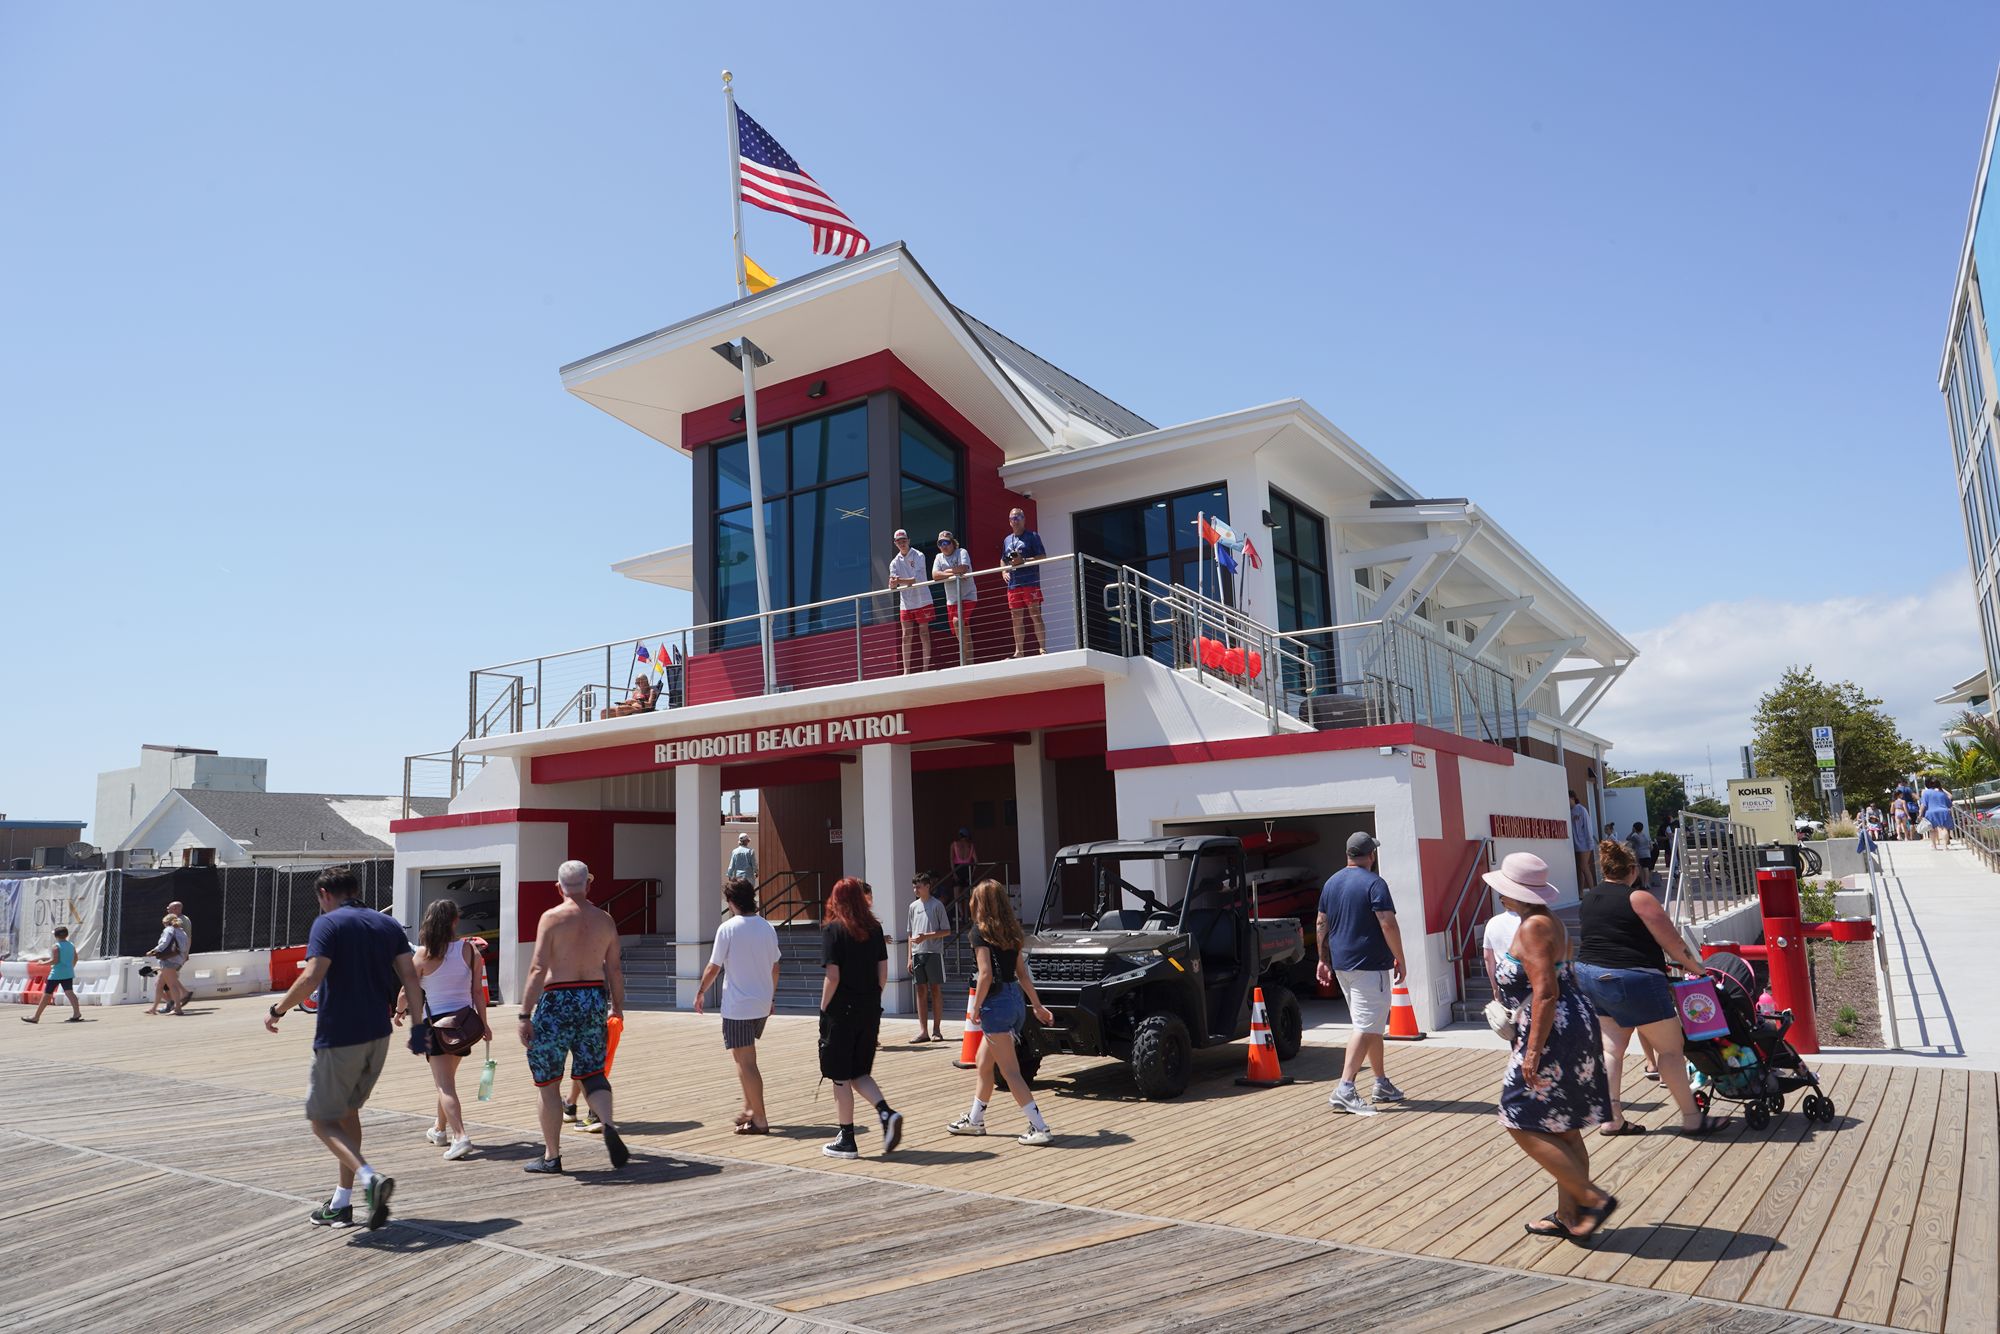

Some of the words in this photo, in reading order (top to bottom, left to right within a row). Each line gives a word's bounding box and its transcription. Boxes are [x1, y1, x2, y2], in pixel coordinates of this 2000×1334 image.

[655, 733, 750, 763] REHOBOTH
[757, 724, 822, 752] BEACH
[828, 713, 910, 743] PATROL
[1738, 787, 1772, 796] KOHLER
[1494, 815, 1530, 838] REHOBOTH
[1039, 962, 1094, 972] POLARIS
